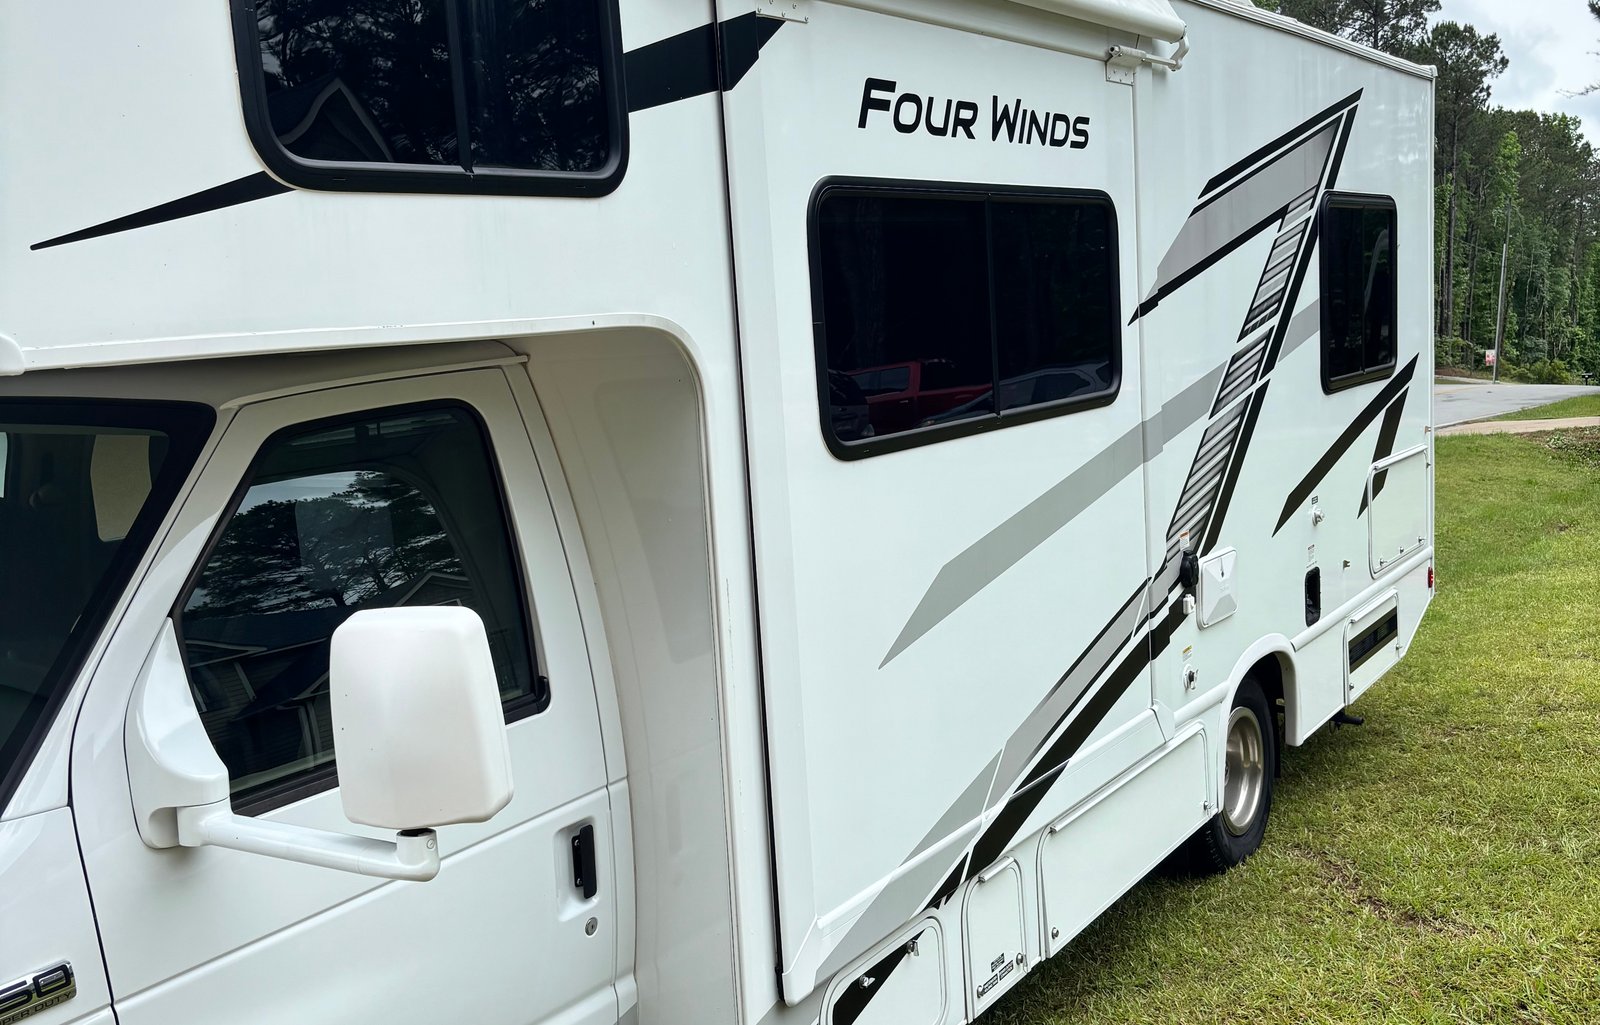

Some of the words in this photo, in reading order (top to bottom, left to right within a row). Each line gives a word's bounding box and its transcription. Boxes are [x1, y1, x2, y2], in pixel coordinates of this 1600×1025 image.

[858, 77, 979, 140] FOUR
[992, 95, 1090, 149] WINDS
[0, 1010, 30, 1025] PER
[34, 991, 71, 1012] DUTY
